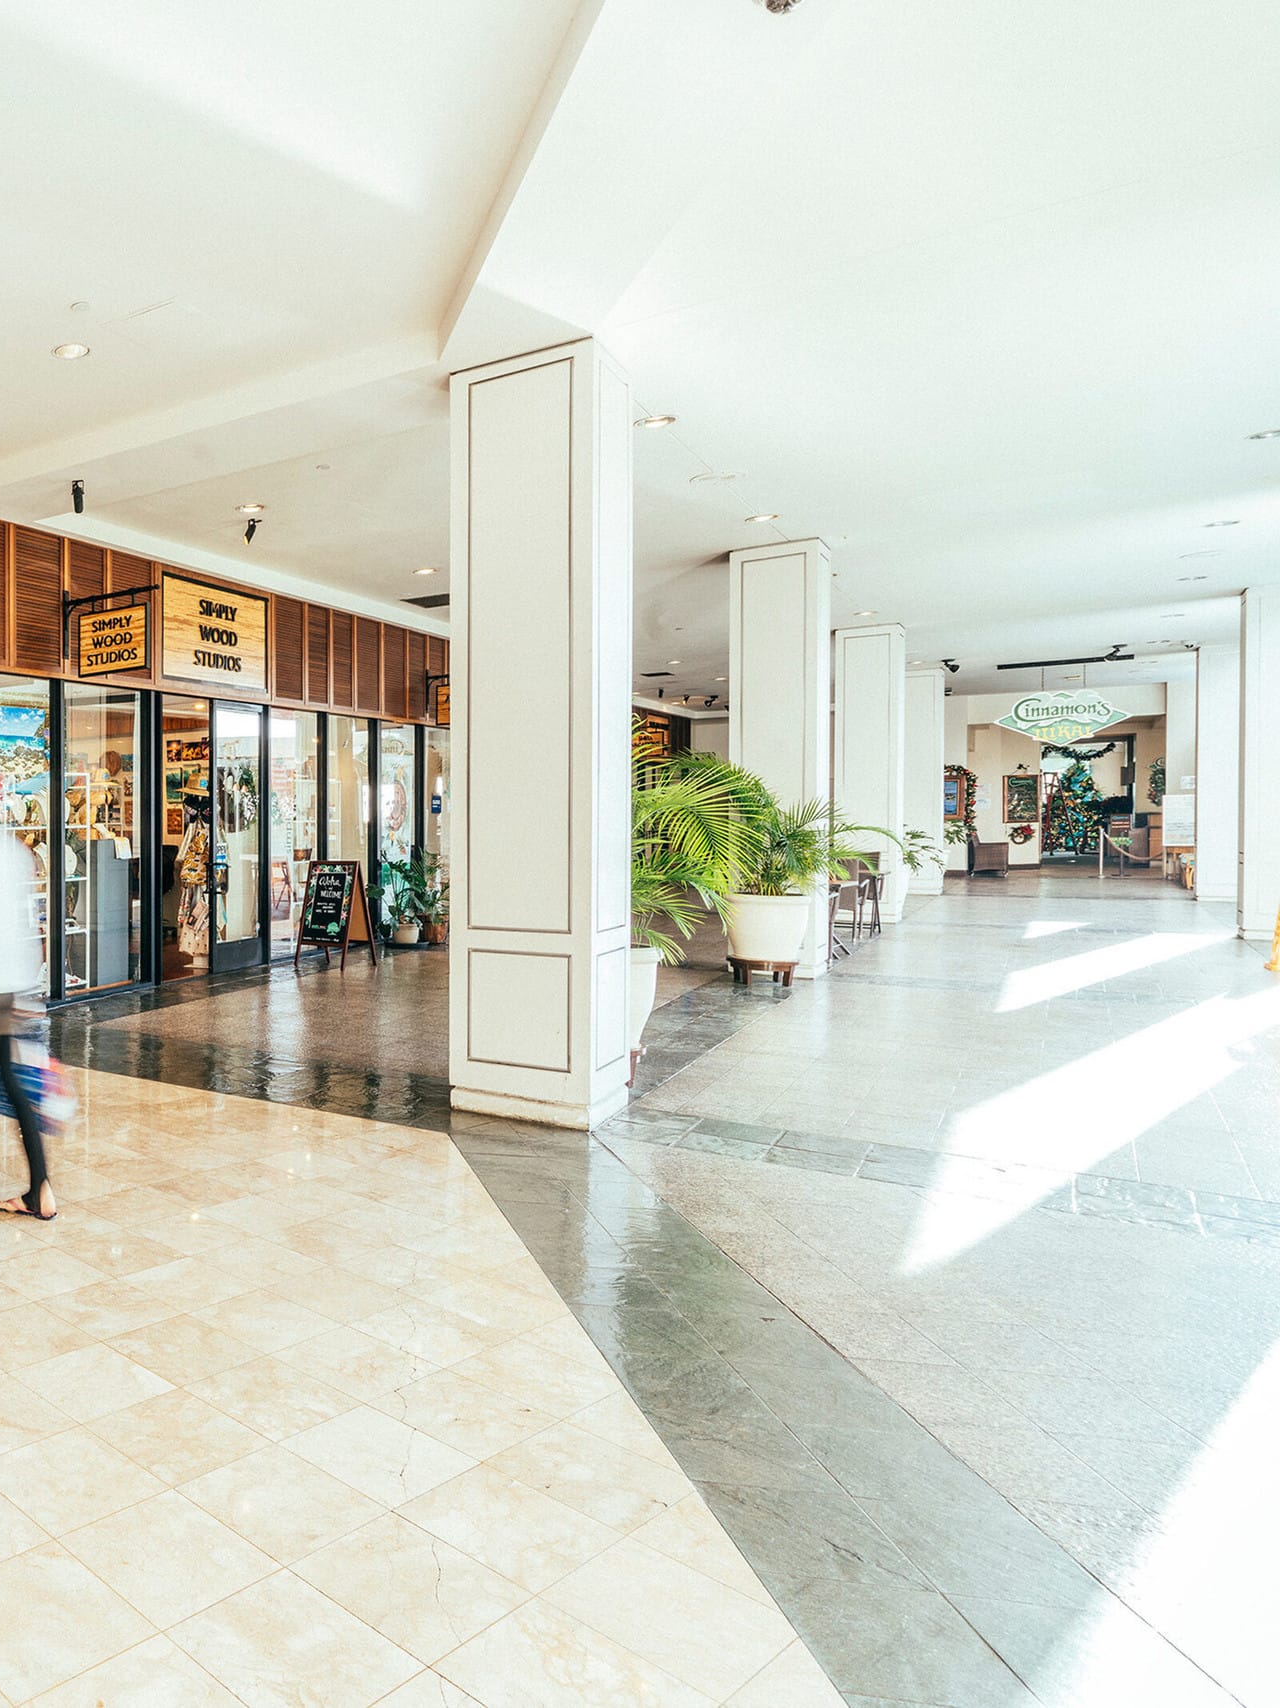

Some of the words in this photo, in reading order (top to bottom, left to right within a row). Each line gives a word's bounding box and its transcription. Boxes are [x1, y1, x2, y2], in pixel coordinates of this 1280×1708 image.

[199, 599, 238, 622] SIMPLY
[91, 615, 132, 633] SIMPLY
[92, 632, 133, 649] WOOD
[199, 624, 238, 647] WOOD
[87, 648, 138, 667] STUDIOS
[194, 650, 241, 672] STUDIOS
[1014, 697, 1111, 722] Cinnamon's
